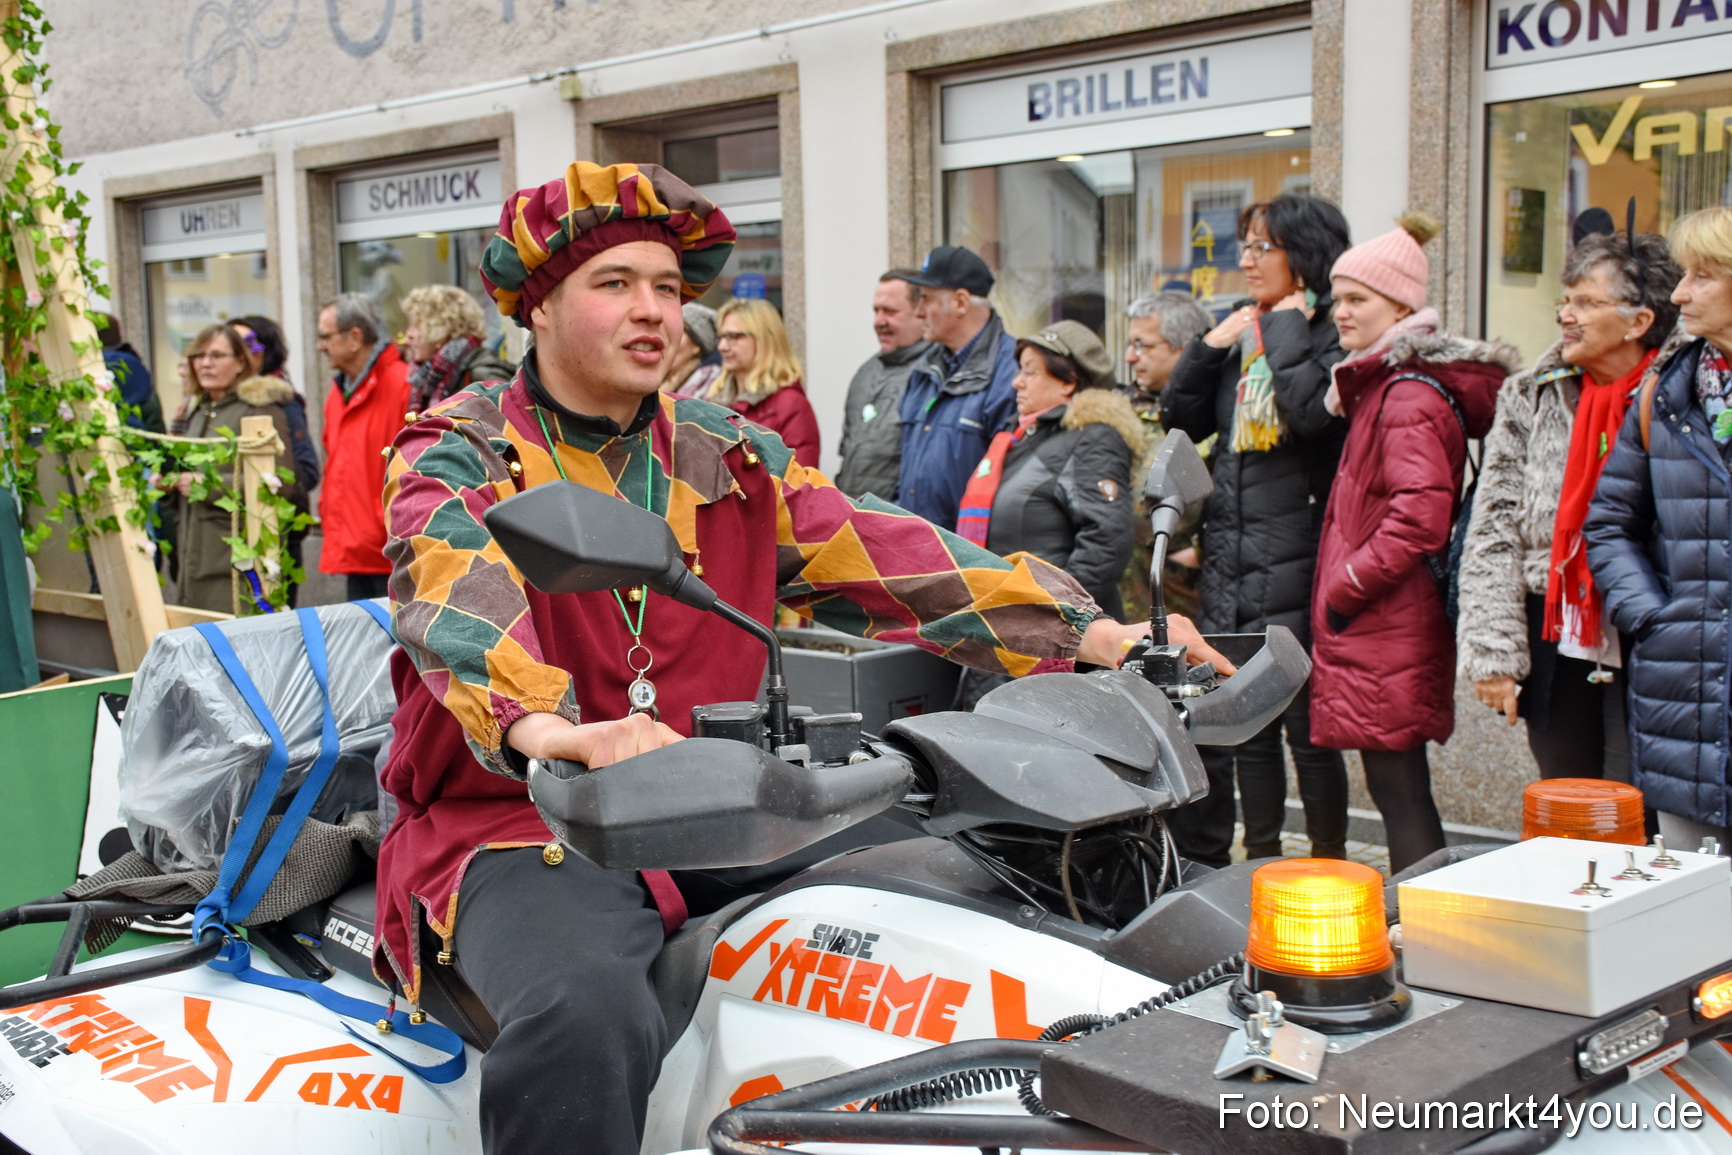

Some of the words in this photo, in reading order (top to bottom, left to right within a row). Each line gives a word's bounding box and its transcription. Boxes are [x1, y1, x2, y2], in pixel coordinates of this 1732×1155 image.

[1497, 0, 1732, 55] KONTA
[1028, 57, 1209, 122] BRILLEN
[369, 169, 481, 212] SCHMUCK
[181, 203, 241, 234] UHREN
[806, 923, 880, 960] SHADE
[752, 938, 971, 1044] XTREME
[297, 1072, 404, 1114] 4X4
